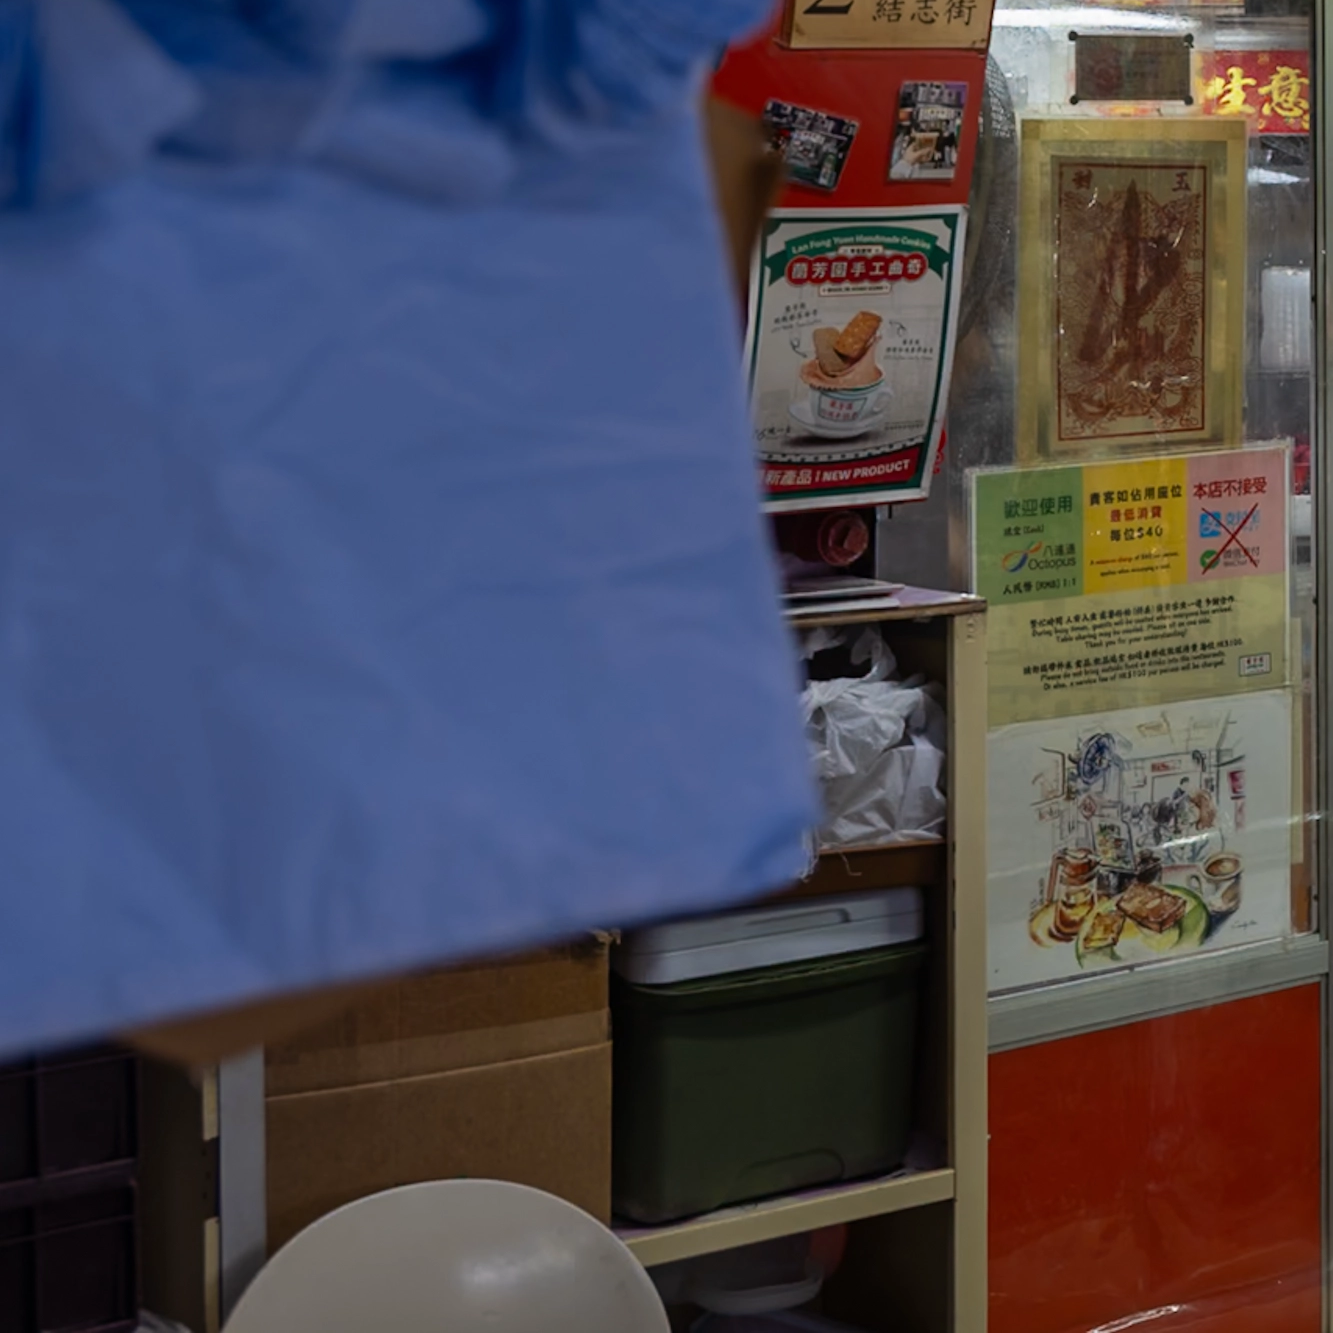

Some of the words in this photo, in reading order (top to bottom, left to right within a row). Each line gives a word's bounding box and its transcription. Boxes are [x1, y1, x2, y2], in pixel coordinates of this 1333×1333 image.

[791, 258, 923, 279] 蘭芳園手工曲奇
[822, 466, 852, 482] NEW
[853, 459, 910, 480] PRODUCT
[1089, 486, 1183, 506] 貴客如佔用座位
[1193, 477, 1267, 500] 本店不接受
[1003, 495, 1073, 518] 歡迎使用
[1110, 506, 1162, 523] 最低消費
[1110, 526, 1163, 542] 每位$40
[1027, 554, 1077, 572] Octopus
